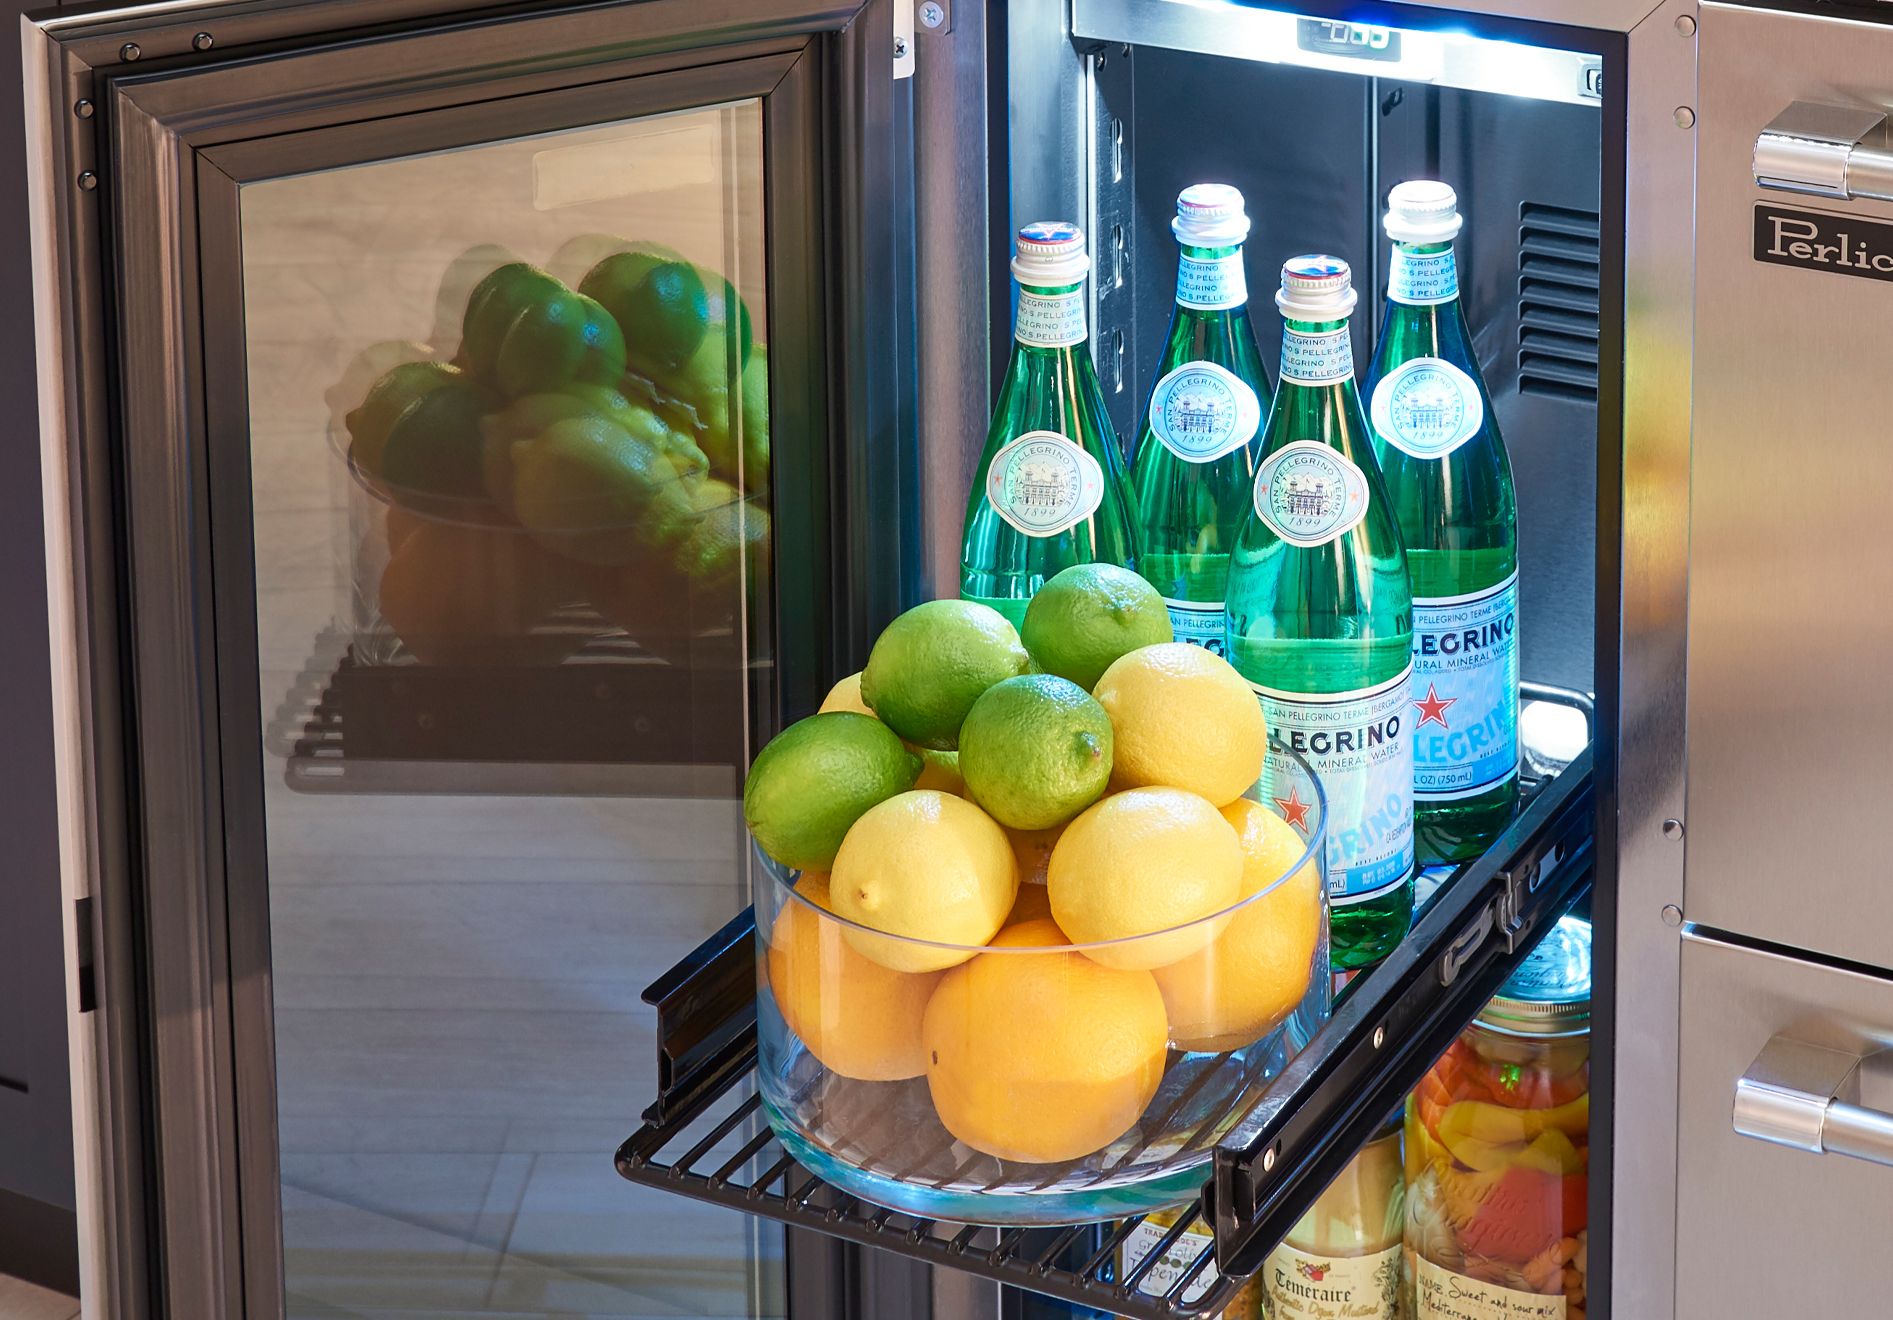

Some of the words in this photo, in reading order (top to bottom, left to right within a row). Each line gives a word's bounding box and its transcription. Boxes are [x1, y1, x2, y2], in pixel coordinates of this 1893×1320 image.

[1767, 215, 1893, 272] Perlic
[1168, 377, 1226, 405] PELLEGRINO
[1394, 373, 1452, 401] PELLEGRINO
[1167, 409, 1176, 432] SAN
[1221, 397, 1234, 435] TERME
[1395, 407, 1403, 430] SAN
[1009, 446, 1071, 476] PELLEGRINO
[1274, 457, 1335, 485] PELLEGRINO
[1007, 479, 1017, 505] SAN
[1066, 466, 1079, 508] TERME
[1328, 476, 1343, 518] TERME
[1273, 489, 1283, 515] SAN
[1289, 516, 1322, 527] 1899
[1418, 613, 1469, 624] PELLEGRINO
[1470, 605, 1493, 619] TERME
[1413, 612, 1515, 656] EGRINO
[1446, 651, 1490, 669] MINERAL
[1268, 706, 1286, 719] SAN
[1288, 710, 1341, 722] PELLEGRINO
[1343, 707, 1370, 720] TERME
[1371, 742, 1399, 761] WATER
[1420, 775, 1436, 785] OZ)
[1438, 773, 1456, 785] (750
[1448, 1275, 1488, 1302] Sweet
[1490, 1295, 1508, 1310] and
[1512, 1303, 1533, 1315] sour
[1536, 1304, 1557, 1317] mix
